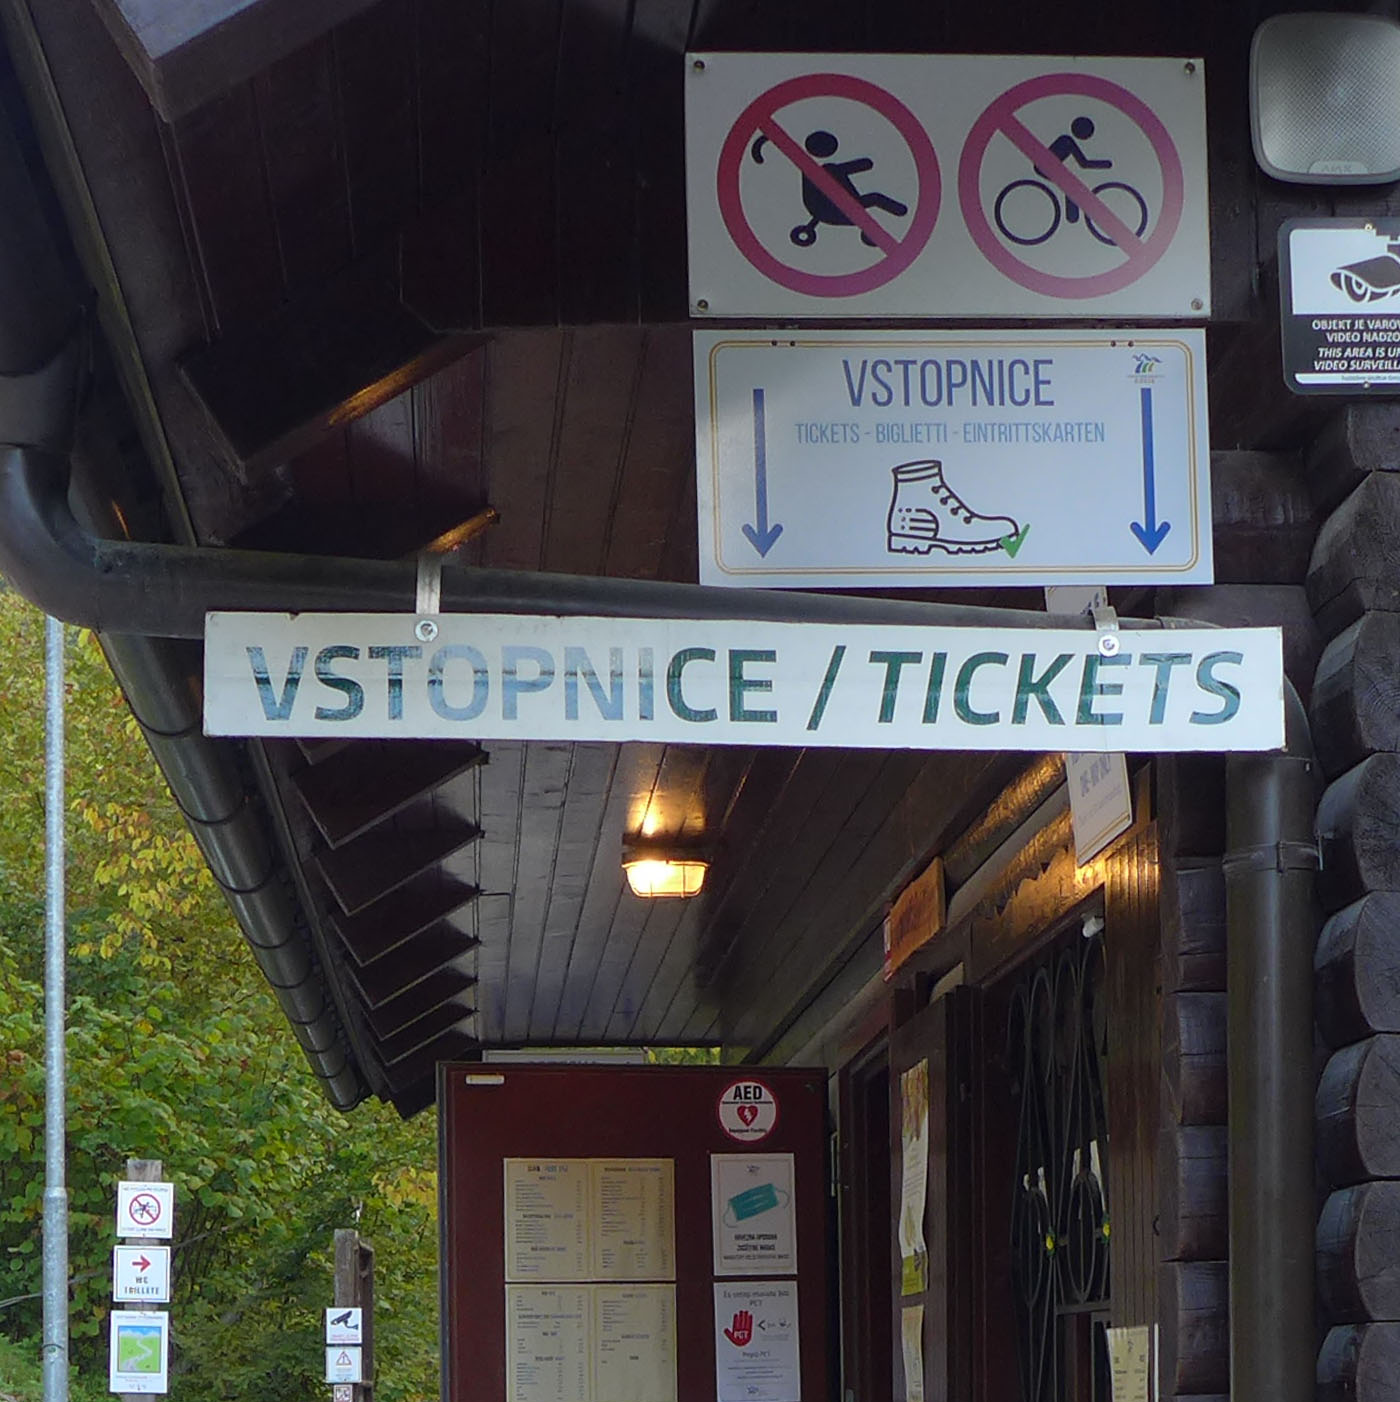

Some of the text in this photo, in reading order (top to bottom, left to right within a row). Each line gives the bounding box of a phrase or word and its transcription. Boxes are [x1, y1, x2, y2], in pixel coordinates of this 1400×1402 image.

[1311, 319, 1352, 330] OBJEKT
[1354, 319, 1365, 330] JE
[1326, 331, 1360, 343] VIDEO
[1318, 347, 1342, 358] THIS
[1344, 347, 1373, 358] AREA
[1375, 347, 1385, 358] IS
[1314, 360, 1348, 371] VIDEO
[842, 359, 1054, 407] VSTOPNICE
[794, 422, 1105, 444] TICKETS BIGLIETTI EINTRITTSKARTEN
[245, 644, 1243, 731] VSTOPNICE / TICKETS
[733, 1085, 763, 1101] AED
